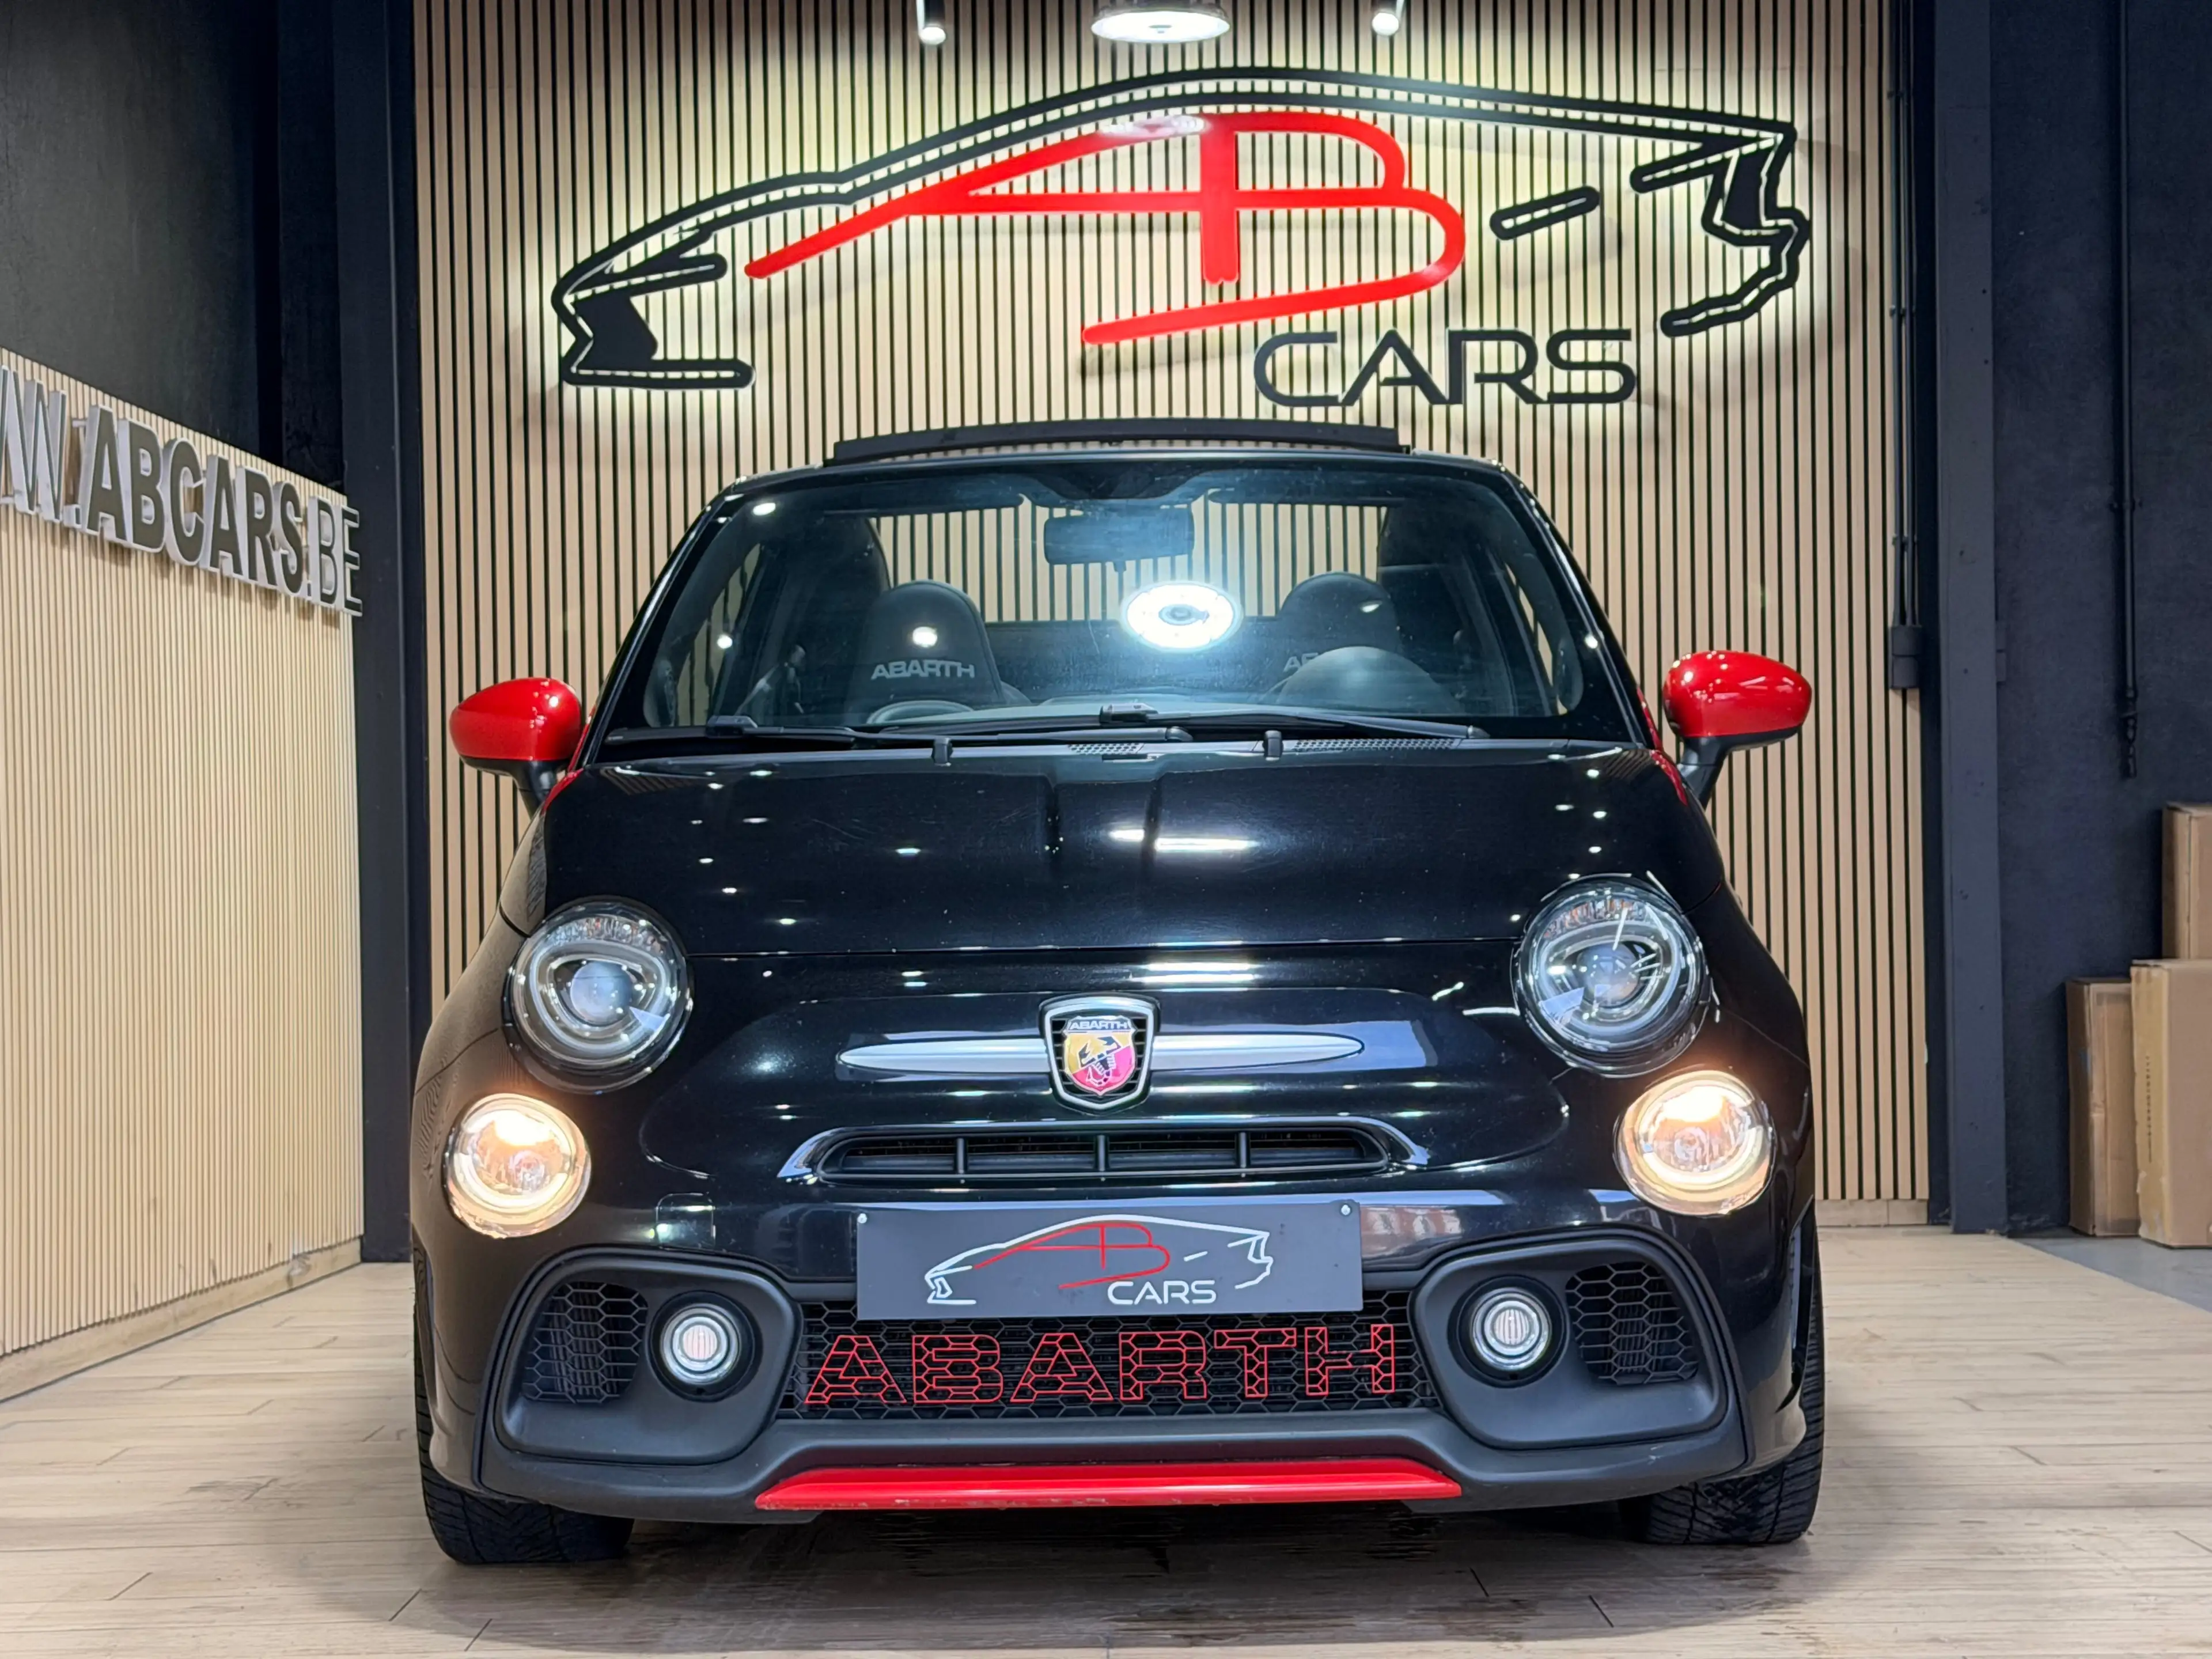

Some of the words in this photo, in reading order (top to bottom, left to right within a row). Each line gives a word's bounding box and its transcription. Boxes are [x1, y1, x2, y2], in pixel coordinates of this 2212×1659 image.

[1253, 328, 1637, 407] CARS
[0, 365, 362, 616] W.ABCARS.BE
[871, 659, 975, 680] ABARTH
[1070, 1020, 1128, 1030] ABARTH
[1107, 1280, 1217, 1305] CARS
[804, 1323, 1395, 1404] ABARTH
